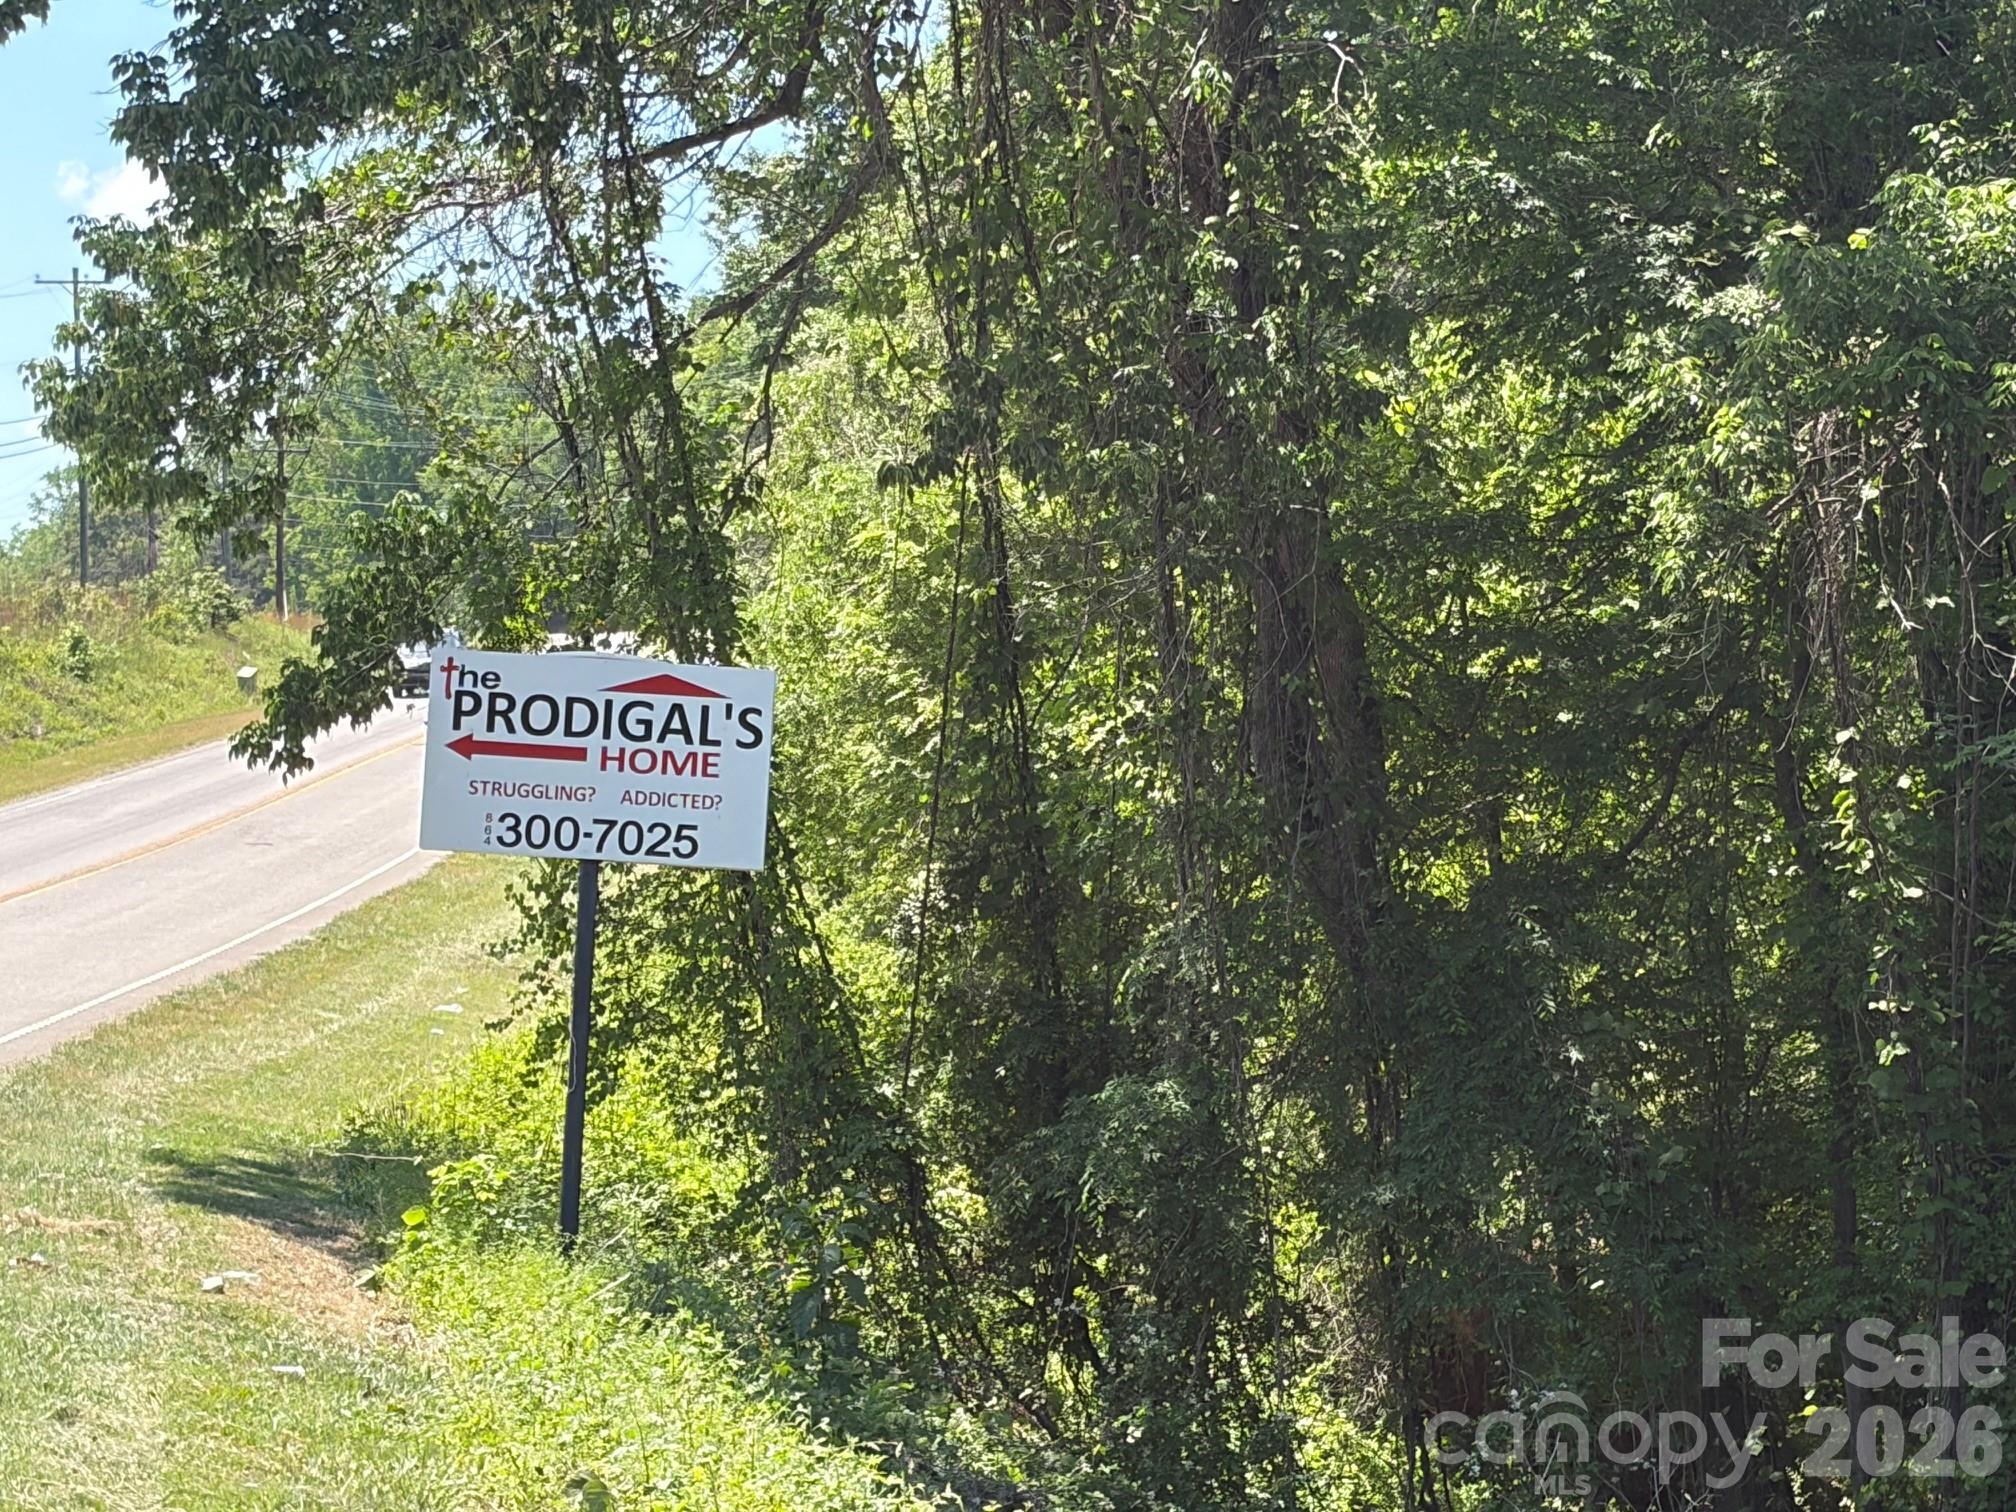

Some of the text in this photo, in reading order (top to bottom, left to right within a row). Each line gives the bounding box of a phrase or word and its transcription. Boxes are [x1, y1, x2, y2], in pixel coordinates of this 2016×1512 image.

[440, 656, 501, 699] the
[452, 689, 763, 750] PRODIGAL'S
[599, 745, 722, 778] HOME
[468, 780, 723, 811] STRUGGLING? ADDICTED?
[496, 812, 699, 859] 300-7025
